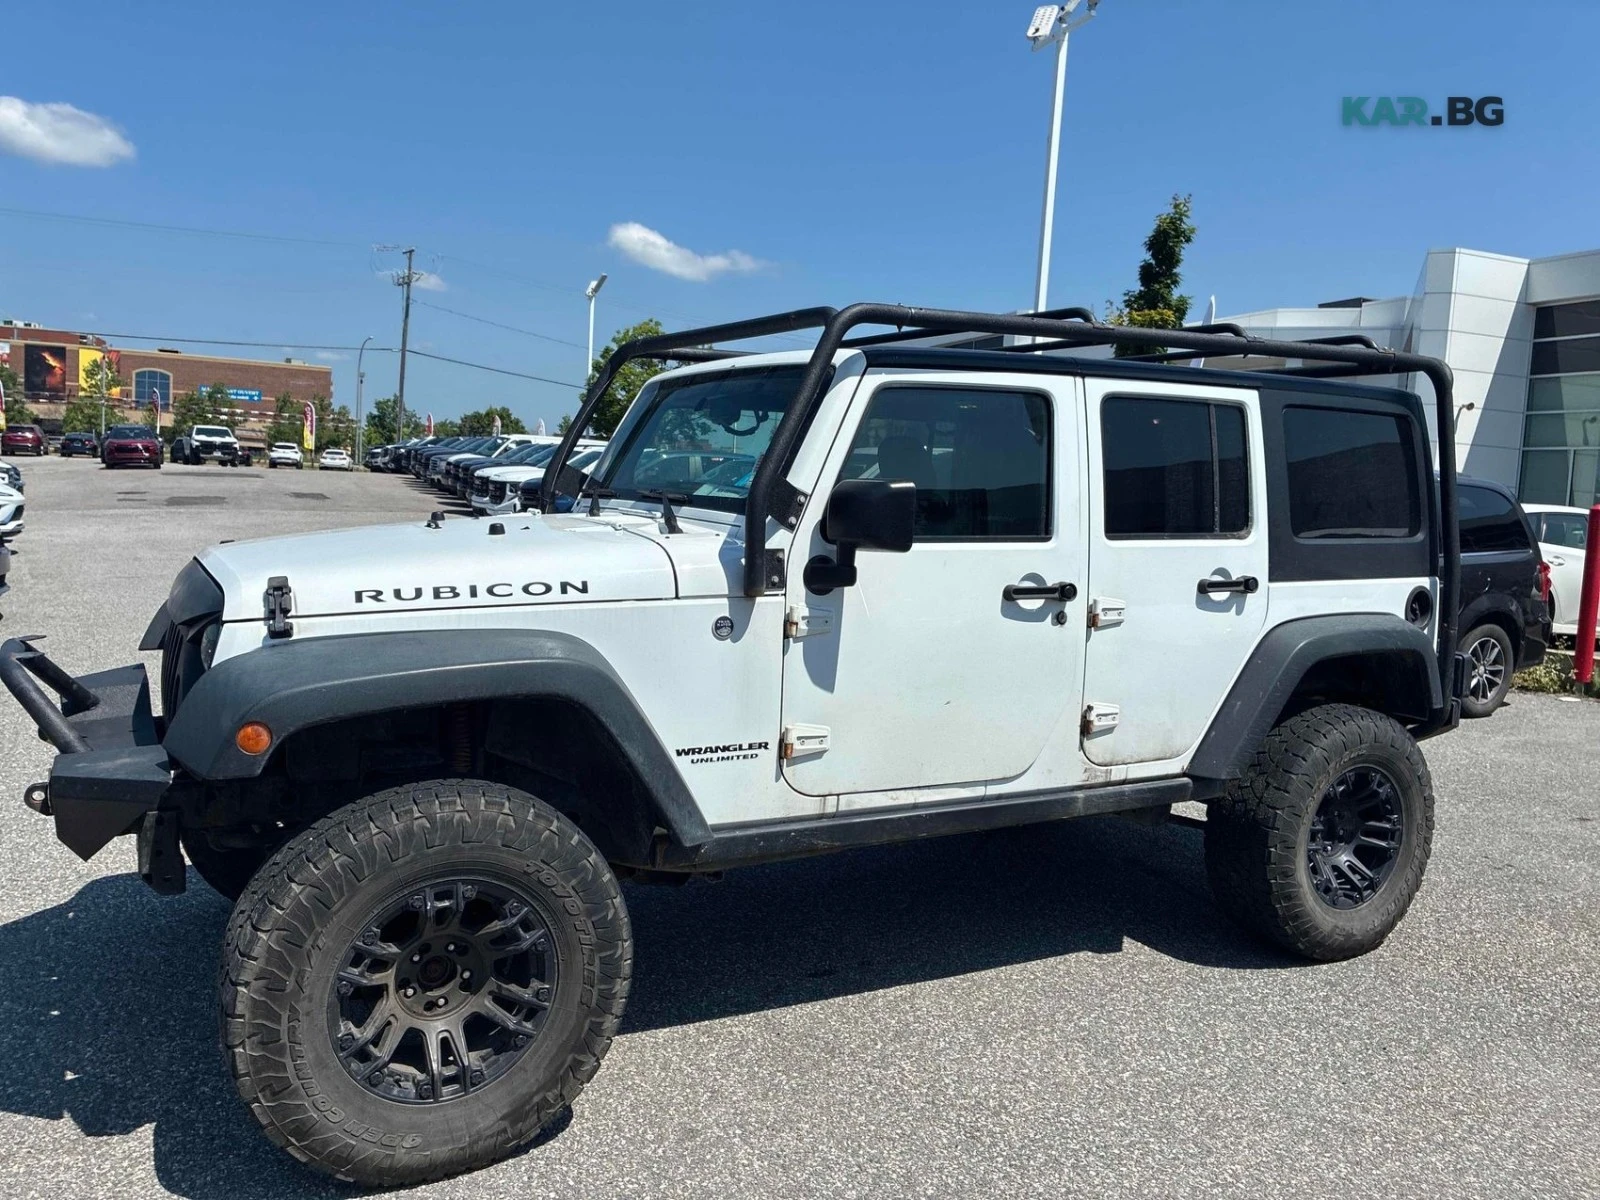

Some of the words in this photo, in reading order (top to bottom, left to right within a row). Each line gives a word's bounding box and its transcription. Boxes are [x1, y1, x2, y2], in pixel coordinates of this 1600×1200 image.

[354, 580, 589, 603] RUBICON
[675, 741, 770, 757] WRANGLER
[690, 753, 759, 764] UNLIMITED
[523, 860, 582, 916] TOYO
[574, 917, 597, 1009] TIRES
[287, 1001, 346, 1124] COUNTRY
[342, 1119, 424, 1149] OPEN
